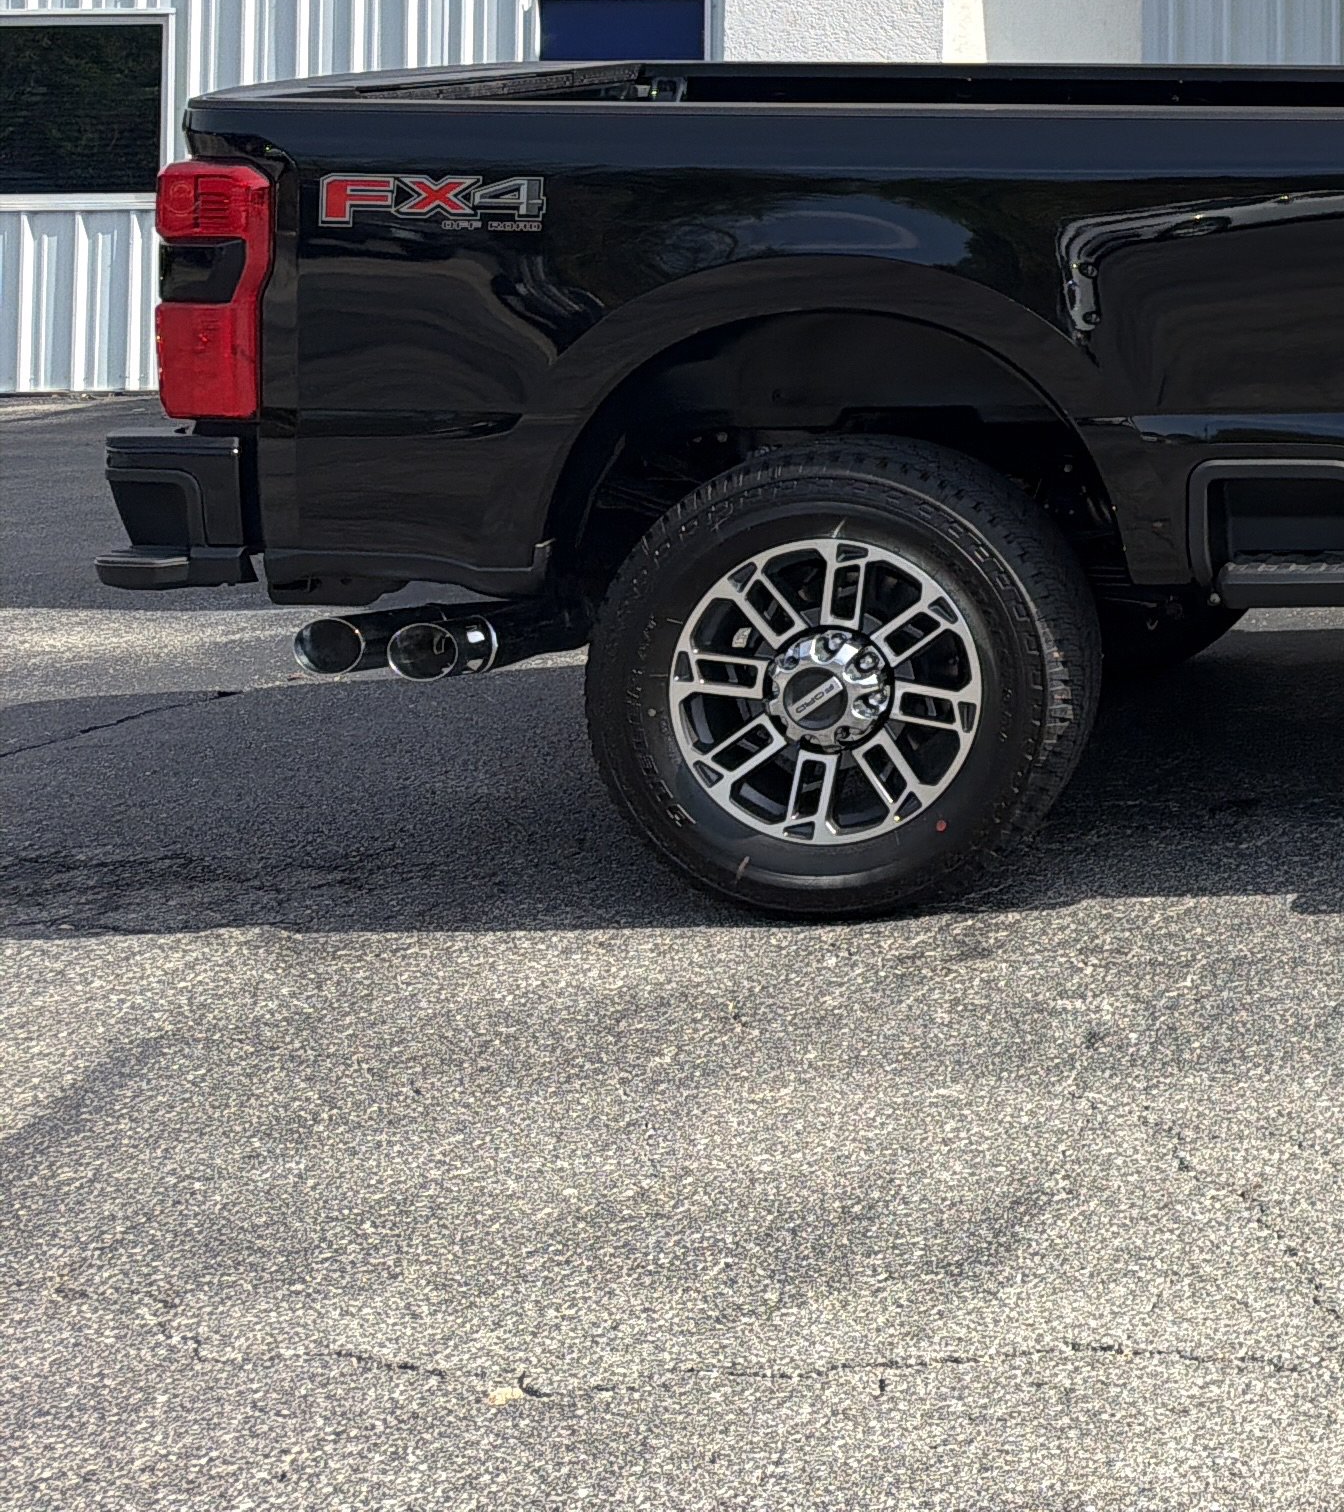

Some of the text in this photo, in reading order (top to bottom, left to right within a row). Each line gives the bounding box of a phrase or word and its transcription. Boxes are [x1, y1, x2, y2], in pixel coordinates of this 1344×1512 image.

[319, 173, 546, 227] FX4
[441, 220, 543, 231] OFF ROAD
[795, 683, 835, 714] FORD
